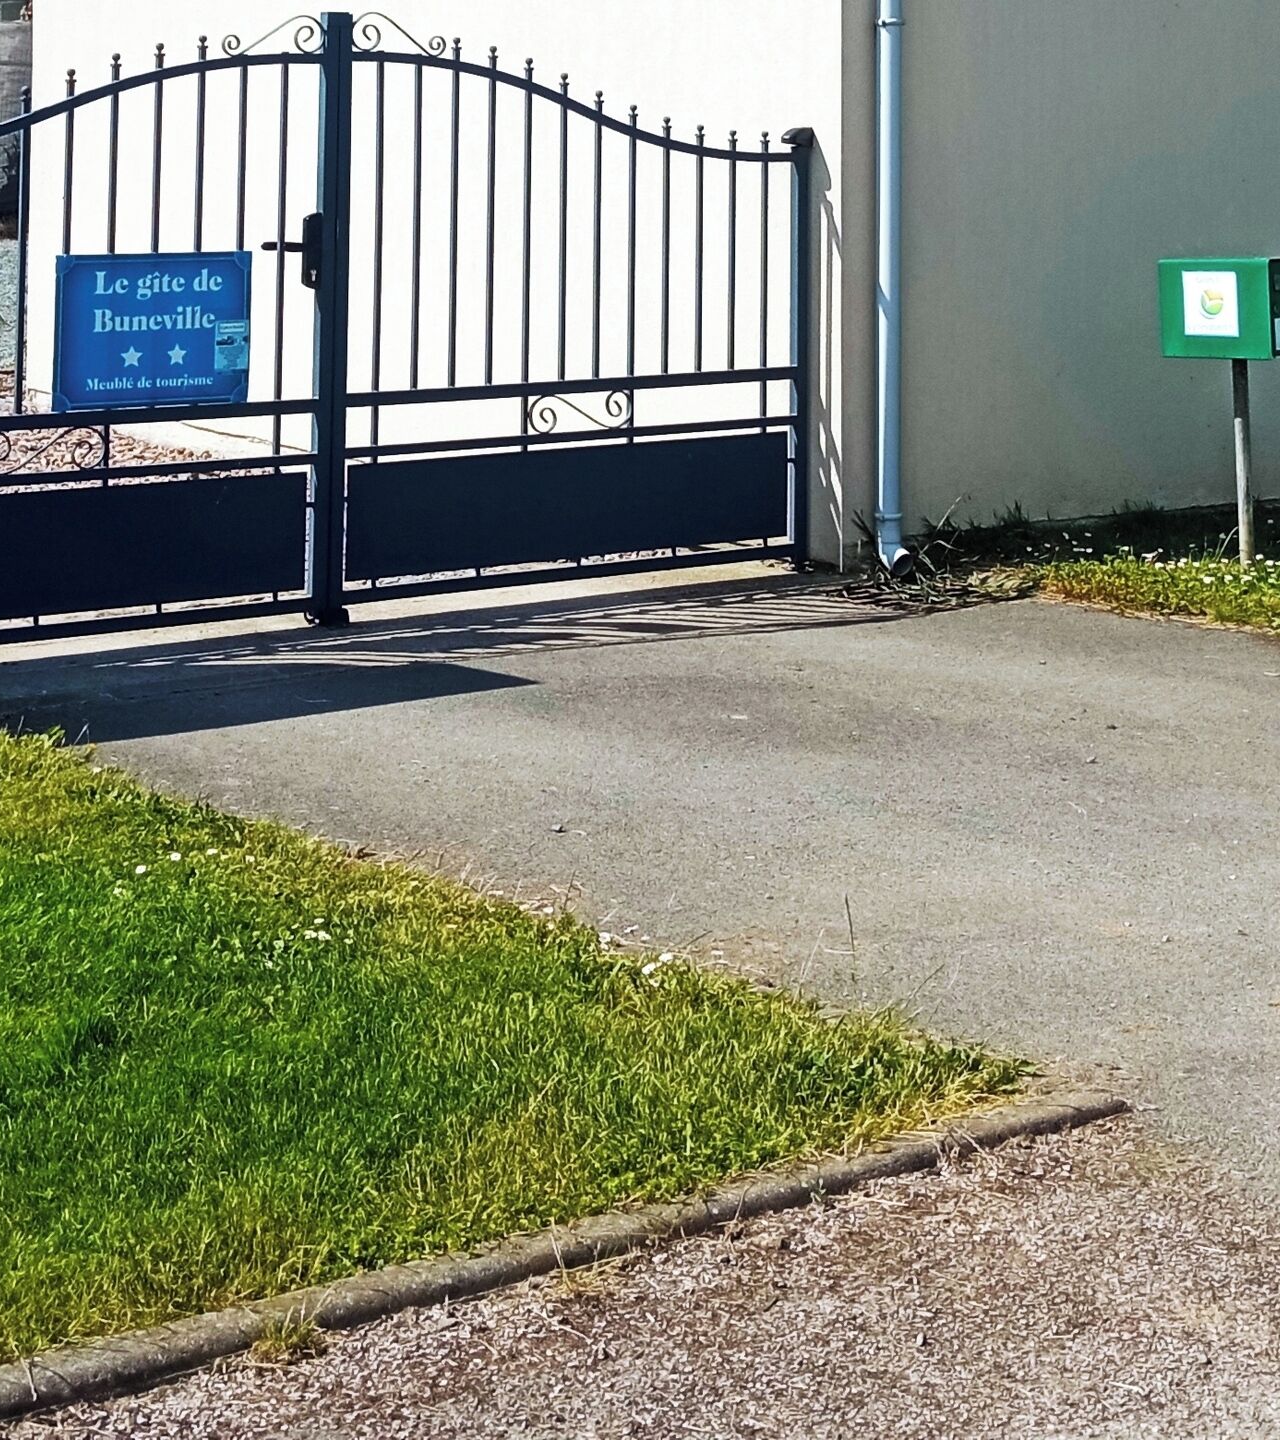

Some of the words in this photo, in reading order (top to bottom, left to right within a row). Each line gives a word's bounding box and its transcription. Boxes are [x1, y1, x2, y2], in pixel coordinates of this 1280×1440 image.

[94, 271, 128, 295] Le
[136, 271, 186, 300] gîte
[192, 268, 223, 292] de
[93, 306, 216, 333] Buneville
[86, 376, 134, 391] Meublé
[137, 376, 153, 389] de
[156, 373, 213, 388] tourisme
